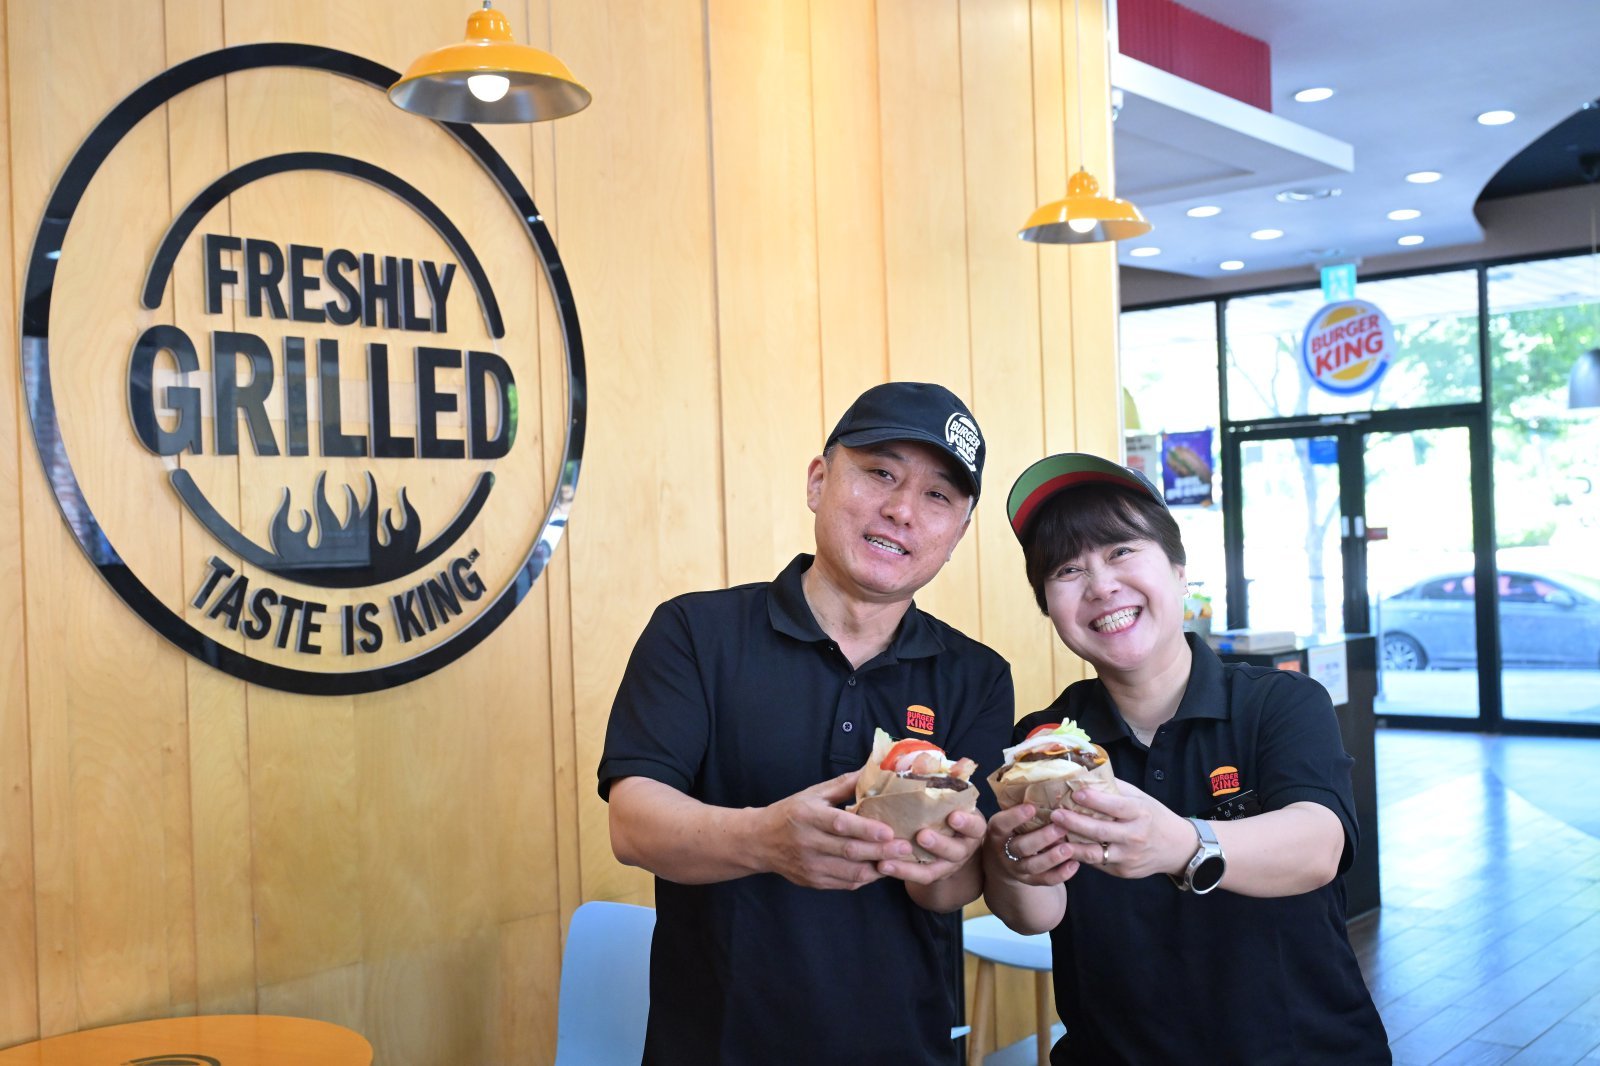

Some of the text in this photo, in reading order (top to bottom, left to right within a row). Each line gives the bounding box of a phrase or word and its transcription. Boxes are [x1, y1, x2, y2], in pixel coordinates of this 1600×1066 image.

[203, 234, 457, 333] FRESHLY
[1311, 314, 1380, 354] BURGER
[1316, 331, 1384, 378] KING
[127, 324, 518, 459] GRILLED
[948, 430, 977, 462] KING
[949, 419, 981, 450] BURGER
[191, 555, 327, 655] TASTE
[340, 602, 383, 656] IS
[389, 557, 487, 643] KING
[906, 717, 934, 731] KING
[907, 711, 935, 724] BURGER
[1211, 773, 1239, 784] BURGER
[1212, 779, 1240, 792] KING
